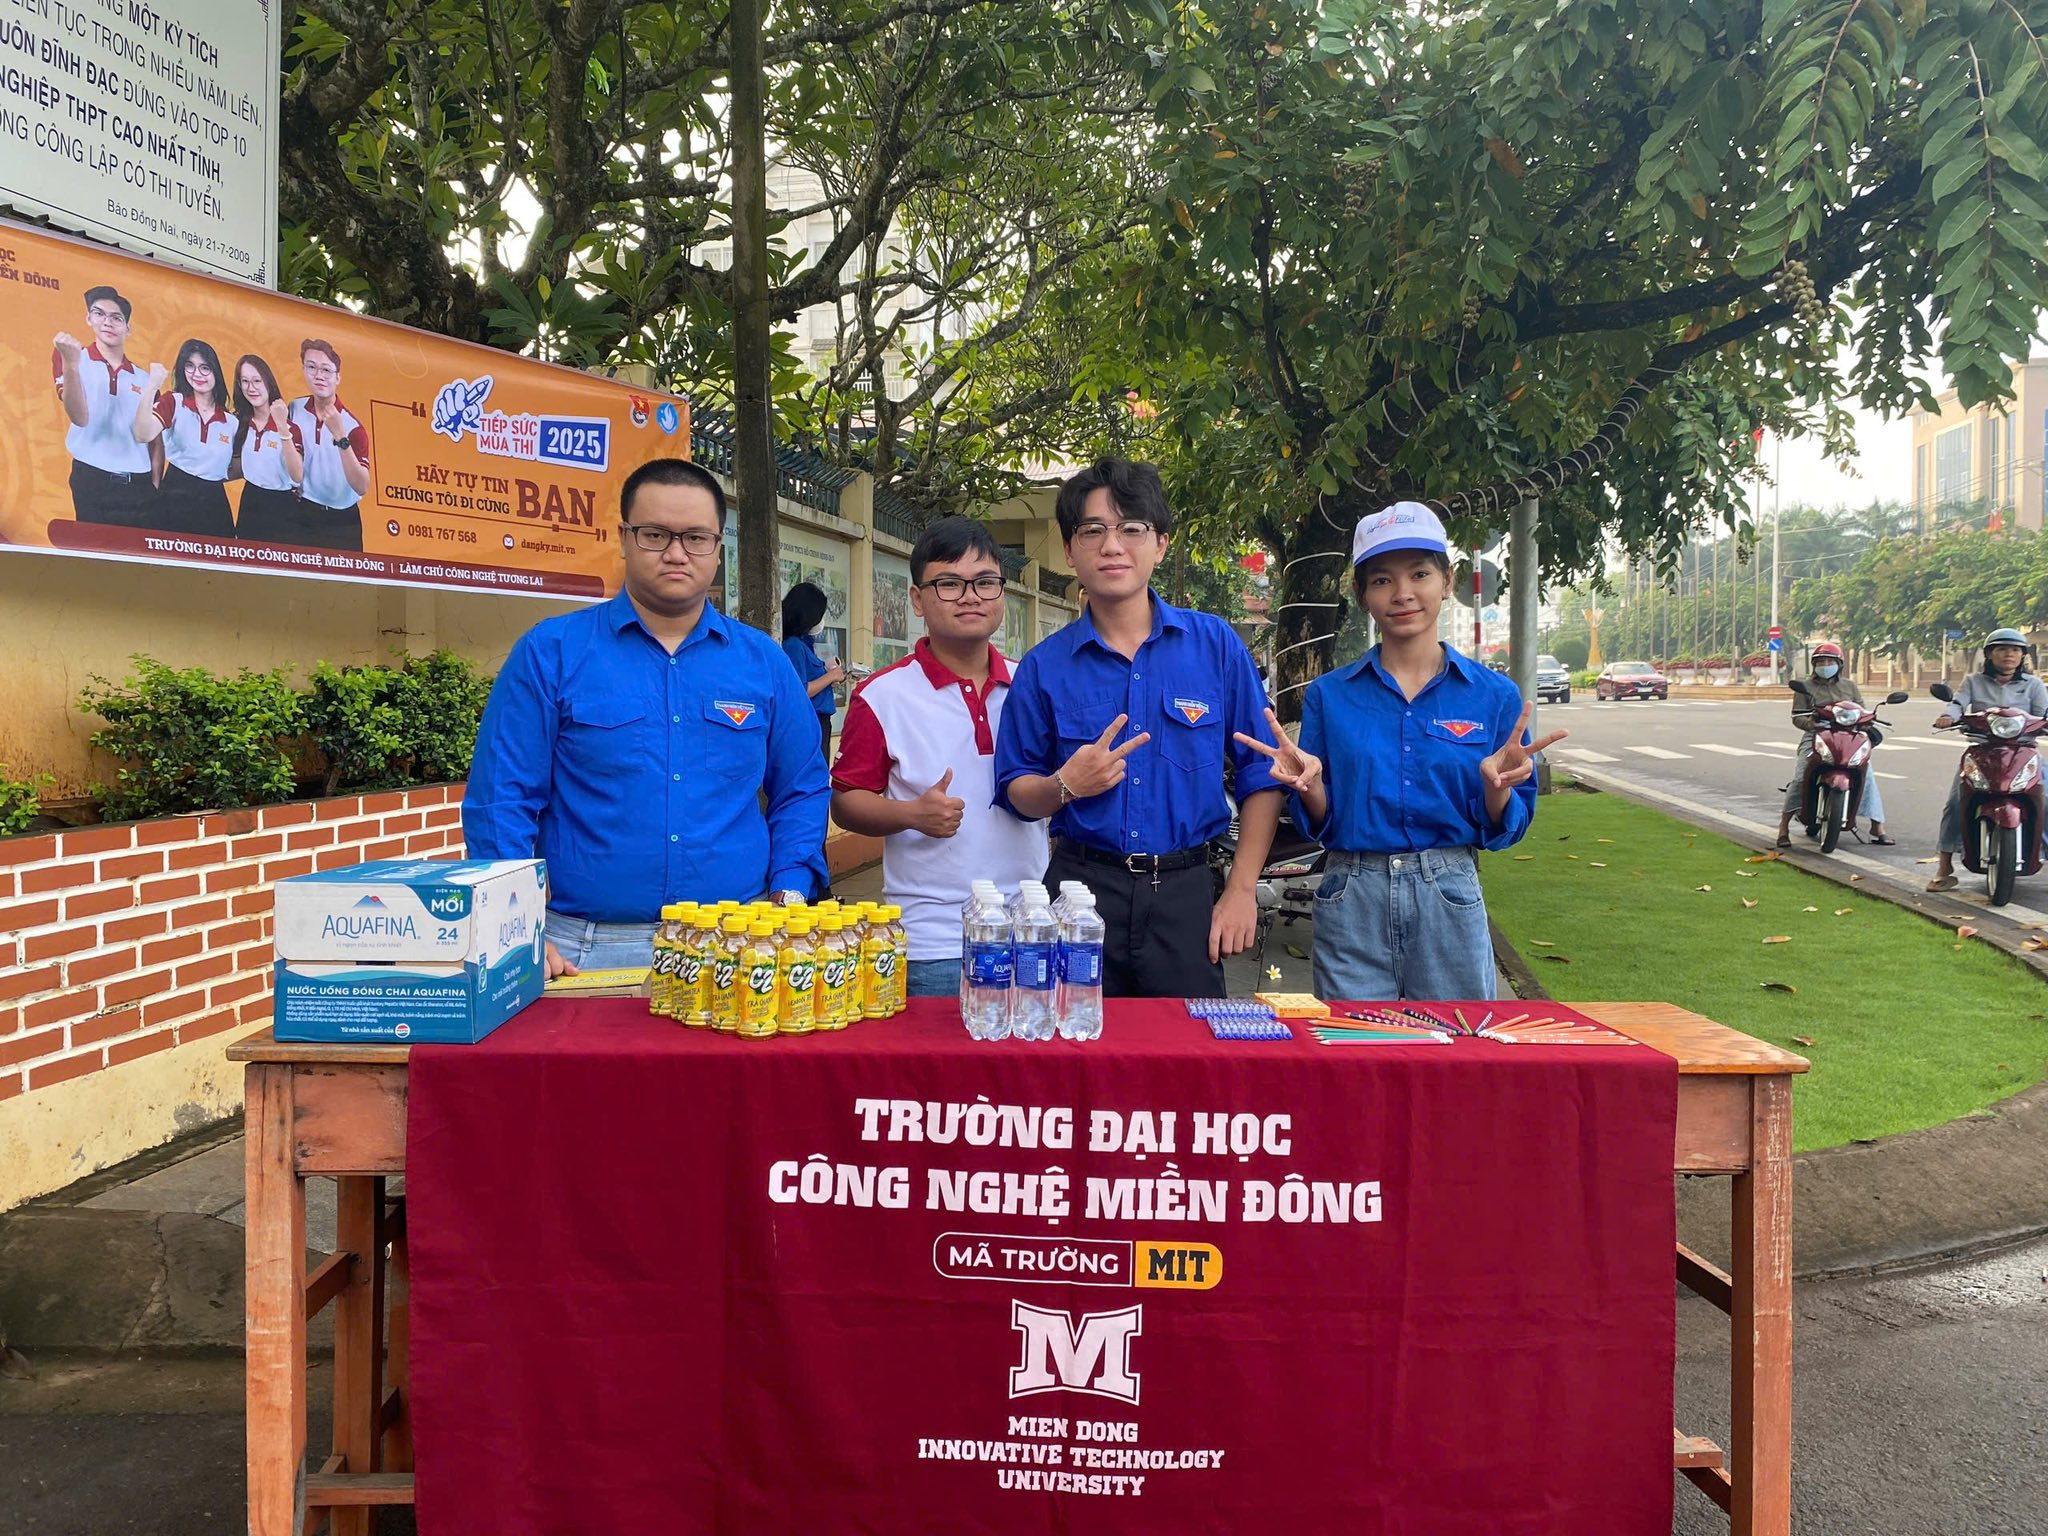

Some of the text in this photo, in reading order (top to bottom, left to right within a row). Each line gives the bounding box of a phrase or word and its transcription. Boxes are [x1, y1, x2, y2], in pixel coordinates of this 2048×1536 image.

[129, 0, 160, 36] MỘT
[165, 20, 183, 48] KỲ
[187, 32, 218, 68] TÍCH
[54, 1, 86, 37] TỤC
[91, 20, 146, 68] TRONG
[150, 51, 194, 92] NHIỀU
[198, 76, 227, 110] NĂM
[41, 38, 81, 78] ĐĨNH
[86, 60, 118, 95] ĐẠC
[123, 79, 166, 119] ĐỨNG
[170, 101, 199, 134] VÀO
[202, 117, 229, 147] TOP
[233, 134, 247, 157] 10
[0, 103, 28, 140] NG
[35, 122, 83, 163] CÔNG
[90, 143, 118, 177] LẬP
[124, 159, 145, 188] CÓ
[149, 170, 172, 199] THI
[66, 93, 107, 132] THPT
[113, 115, 144, 148] CAO
[148, 131, 186, 167] NHẤT
[190, 145, 224, 188] TỈNH,
[107, 199, 128, 218] Báo
[131, 208, 157, 232] Đồng
[182, 230, 203, 249] ngày
[206, 237, 250, 264] 21-7-2009
[479, 414, 538, 437] TIẾP SỨC
[480, 433, 534, 455] MÙA THI
[547, 426, 601, 459] 2025
[416, 464, 509, 494] HÃY TỰ TIN
[385, 485, 510, 514] CHÚNG TÔI ĐI CÙNG
[515, 479, 595, 532] BẠN
[408, 524, 477, 544] 0981 767 568
[521, 538, 576, 555] dangky.mit.vn
[145, 537, 385, 572] TRƯỜNG ĐẠI HỌC CÔNG NGHỆ MIỀN ĐÔNG
[399, 562, 544, 586] LÀM CHỦ CÔNG NGHỆ TƯƠNG LAI
[322, 914, 417, 940] AQUAFINA
[437, 928, 458, 940] 24
[653, 949, 673, 974] C2
[714, 961, 734, 989] C2
[823, 961, 845, 988] C2
[875, 952, 895, 977] C2
[287, 985, 466, 997] NƯỚC UỐNG ĐÓNG CHAI AQUAFINA
[749, 967, 776, 994] C2
[788, 964, 815, 991] C2
[855, 1095, 1292, 1162] TRƯỜNG ĐẠI HỌC
[768, 1153, 1383, 1225] CÔNG NGHỆ MIỀN ĐÔNG
[949, 1242, 1210, 1283] MÃ TRƯỜNG MIT
[1007, 1416, 1138, 1443] MIEN DONG
[918, 1439, 1225, 1470] INNOVATIVE TECHNOLOGY
[998, 1469, 1145, 1496] UNIVERSITY
